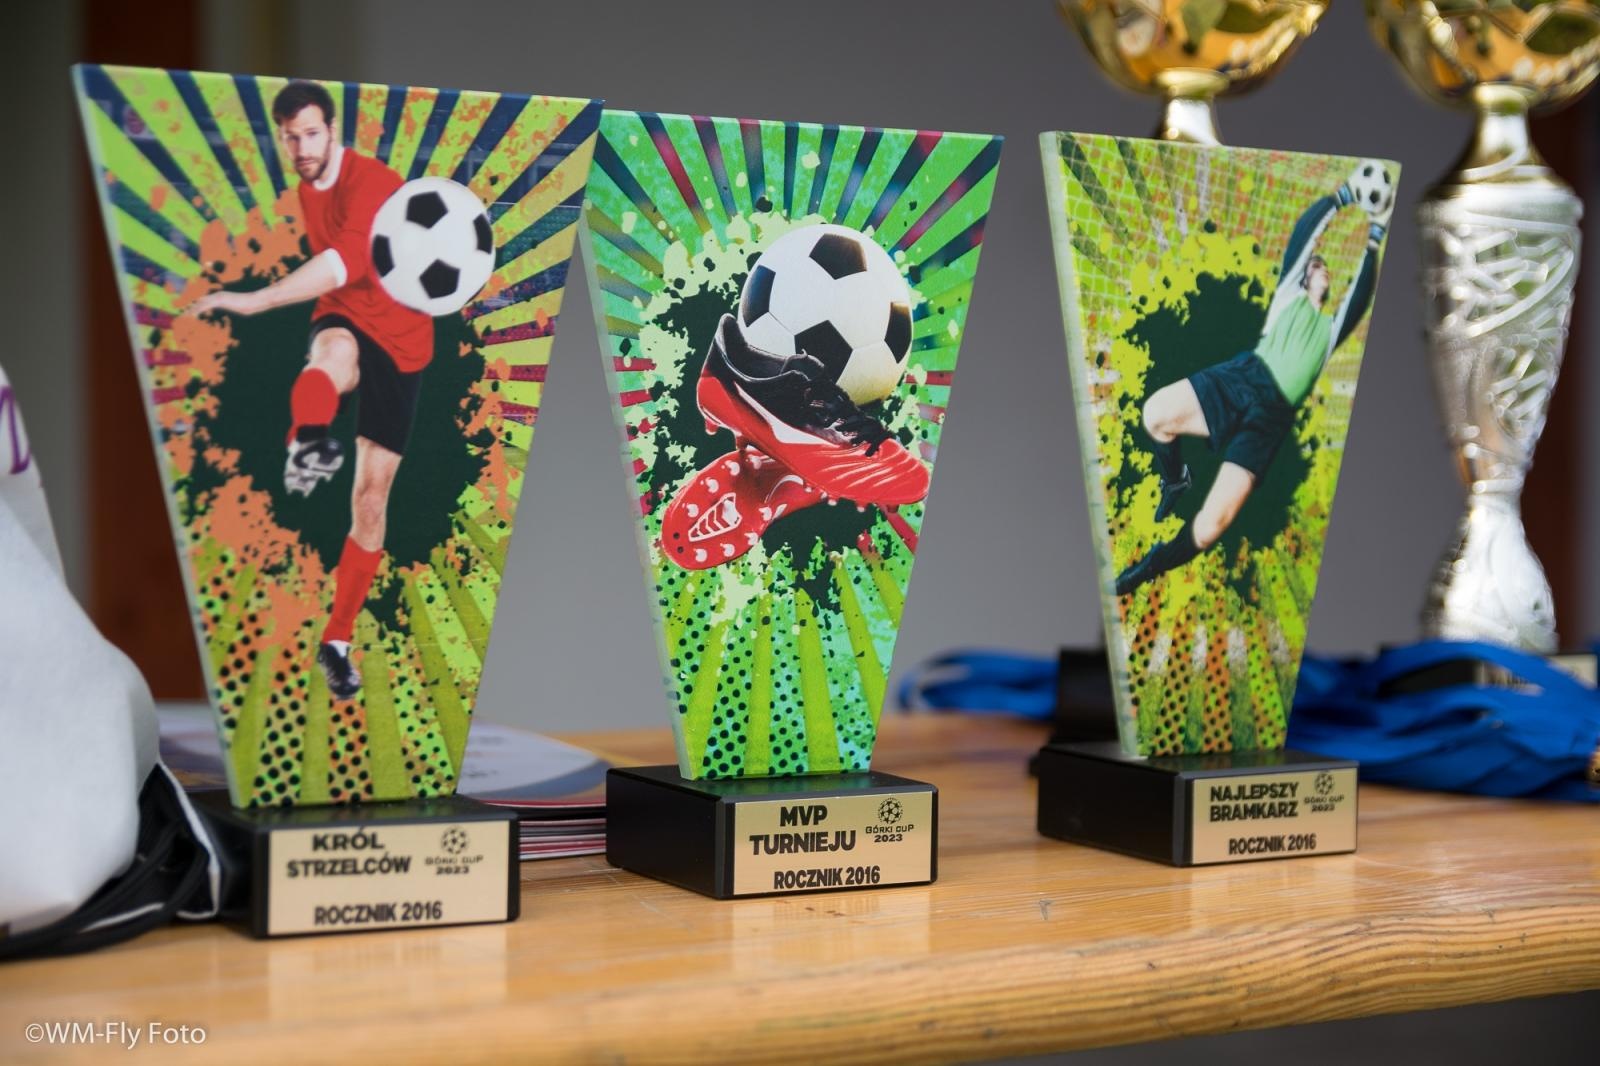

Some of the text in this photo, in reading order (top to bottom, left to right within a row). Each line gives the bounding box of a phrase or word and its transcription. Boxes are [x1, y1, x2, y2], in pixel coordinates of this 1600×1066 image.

[1210, 782, 1299, 802] NAJLEPSZY
[780, 805, 828, 827] MVP
[1210, 801, 1299, 822] BRAMKARZ
[1311, 803, 1335, 812] 2023
[312, 827, 385, 851] KRÓL
[865, 824, 914, 834] GÓRKI CUP
[874, 834, 903, 843] 2023
[749, 830, 856, 855] TURNIEJU
[1228, 833, 1317, 855] ROCZNIK 2016
[286, 852, 412, 878] STRZELCÓW
[435, 865, 470, 875] 2023
[774, 865, 881, 890] ROCZNIK 2016
[314, 901, 443, 925] ROCZNIK 2016
